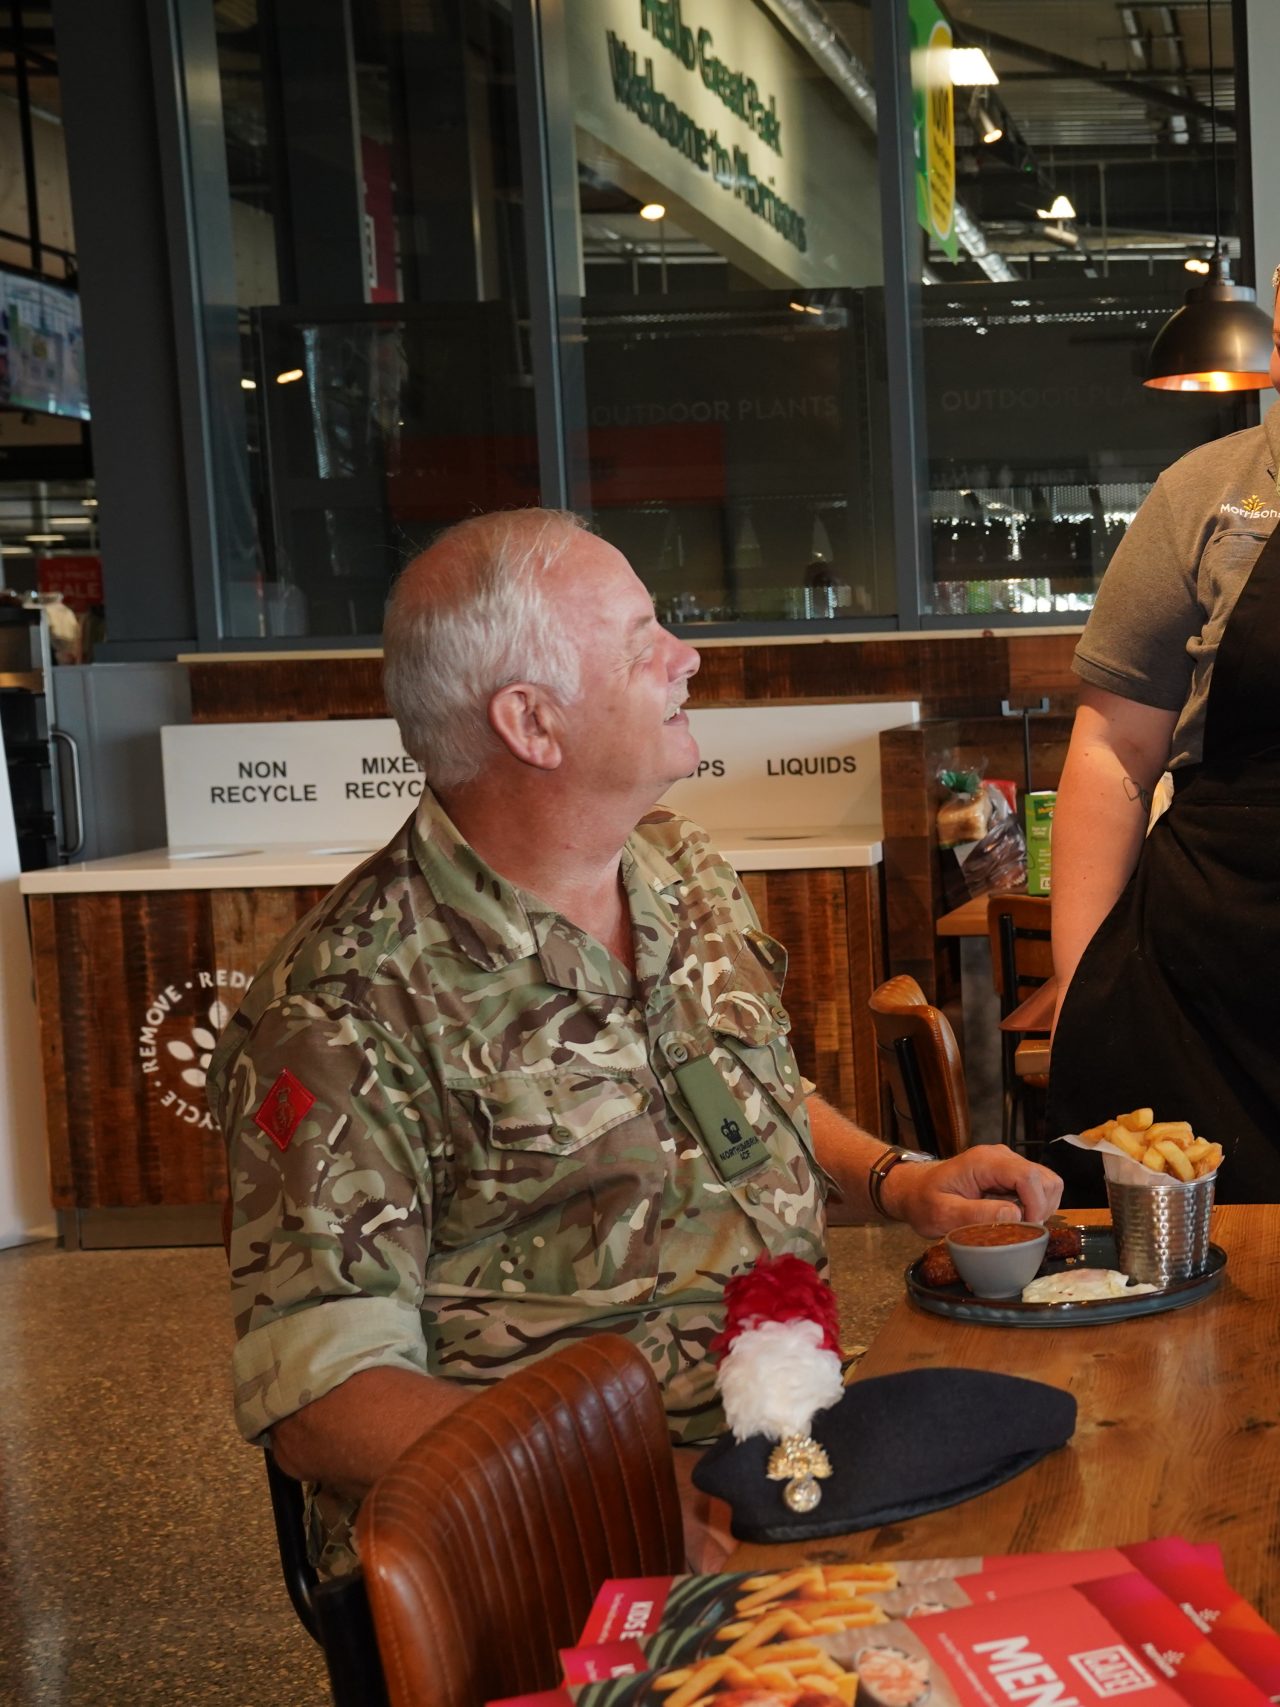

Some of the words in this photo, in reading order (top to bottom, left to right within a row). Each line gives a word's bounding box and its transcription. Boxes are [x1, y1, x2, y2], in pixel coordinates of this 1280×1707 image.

[698, 27, 748, 122] Great
[606, 30, 709, 171] Welcome
[708, 129, 733, 190] to
[733, 145, 807, 252] Morrisons
[591, 400, 731, 427] OUTDOOR
[738, 395, 840, 420] PLANTS
[239, 761, 288, 779] NON
[688, 760, 726, 778] PS
[766, 756, 857, 777] LIQUIDS
[211, 785, 318, 804] RECYCLE
[139, 984, 183, 1074] REMOVE
[160, 1090, 222, 1131] YCLE
